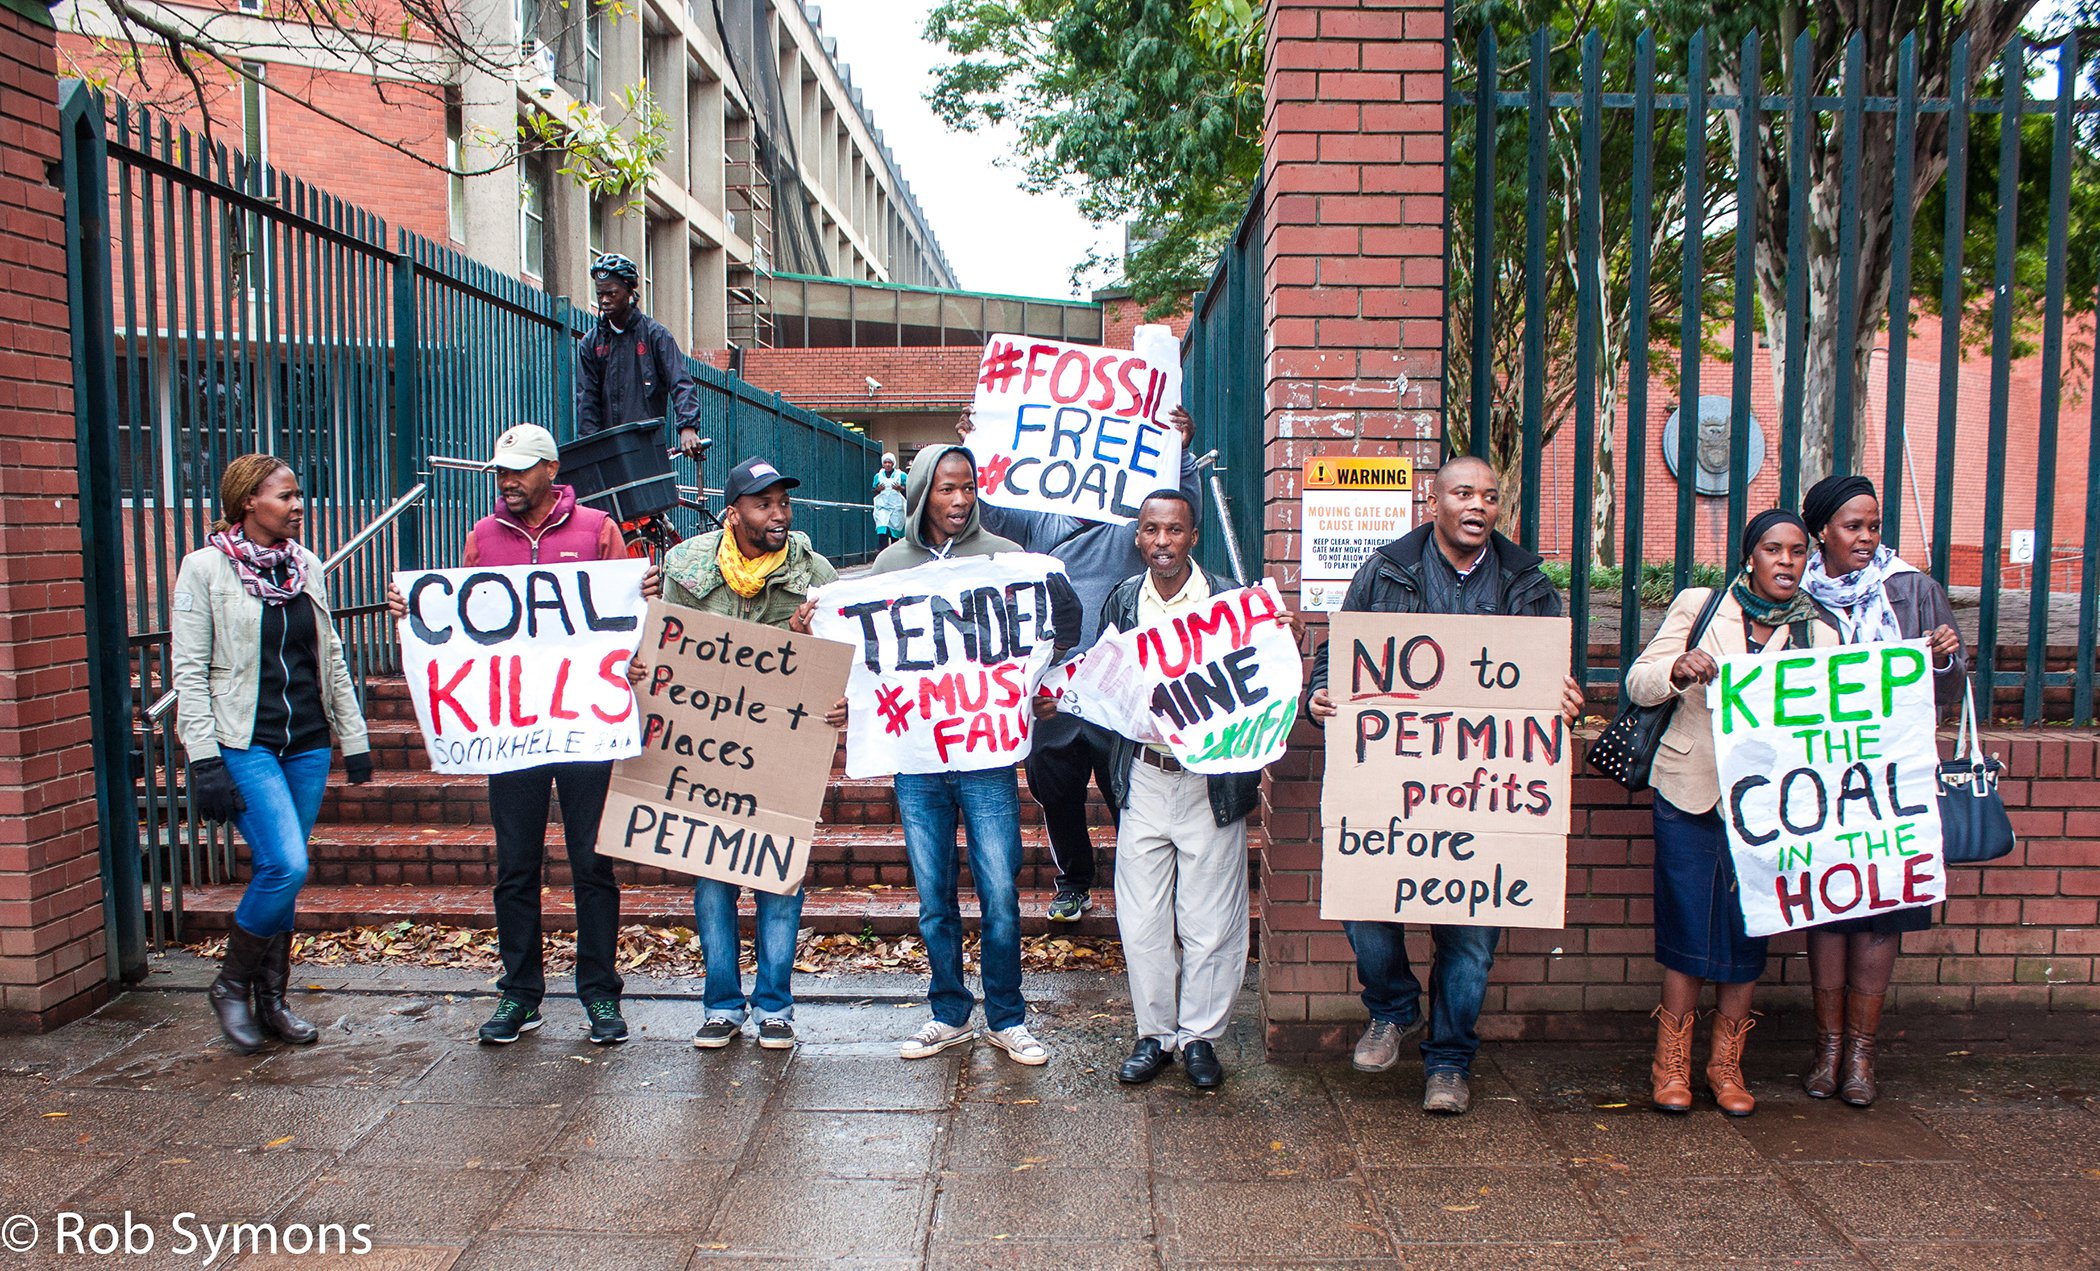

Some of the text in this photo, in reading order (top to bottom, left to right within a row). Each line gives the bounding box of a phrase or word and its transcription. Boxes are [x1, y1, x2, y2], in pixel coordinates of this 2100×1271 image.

[979, 340, 1170, 430] #FOSSIL
[1012, 404, 1163, 478] FREE
[977, 454, 1140, 519] #COAL
[1337, 469, 1407, 485] WARNING
[1308, 506, 1406, 518] MOVING GATE CAN
[1319, 520, 1396, 531] CAUSE INJURY
[1364, 538, 1397, 546] TAILGATIN
[409, 570, 638, 646] COAL
[657, 616, 797, 675] Protect
[1351, 634, 1520, 694] NO to
[427, 649, 633, 736] KILLS
[650, 665, 808, 731] People +
[874, 662, 1028, 738] #MUS
[1721, 647, 1926, 734] KEEP
[433, 729, 586, 765] SOMKHELE
[643, 713, 754, 769] Places
[1355, 709, 1563, 767] PETMIN
[1792, 724, 1882, 764] THE
[666, 765, 757, 817] from
[1401, 767, 1552, 819] profits
[1730, 762, 1928, 847] COAL
[625, 804, 795, 882] PETMIN
[1338, 816, 1475, 861] before
[1778, 823, 1919, 871] IN THE
[1395, 863, 1533, 917] people
[1775, 853, 1936, 926] HOLE
